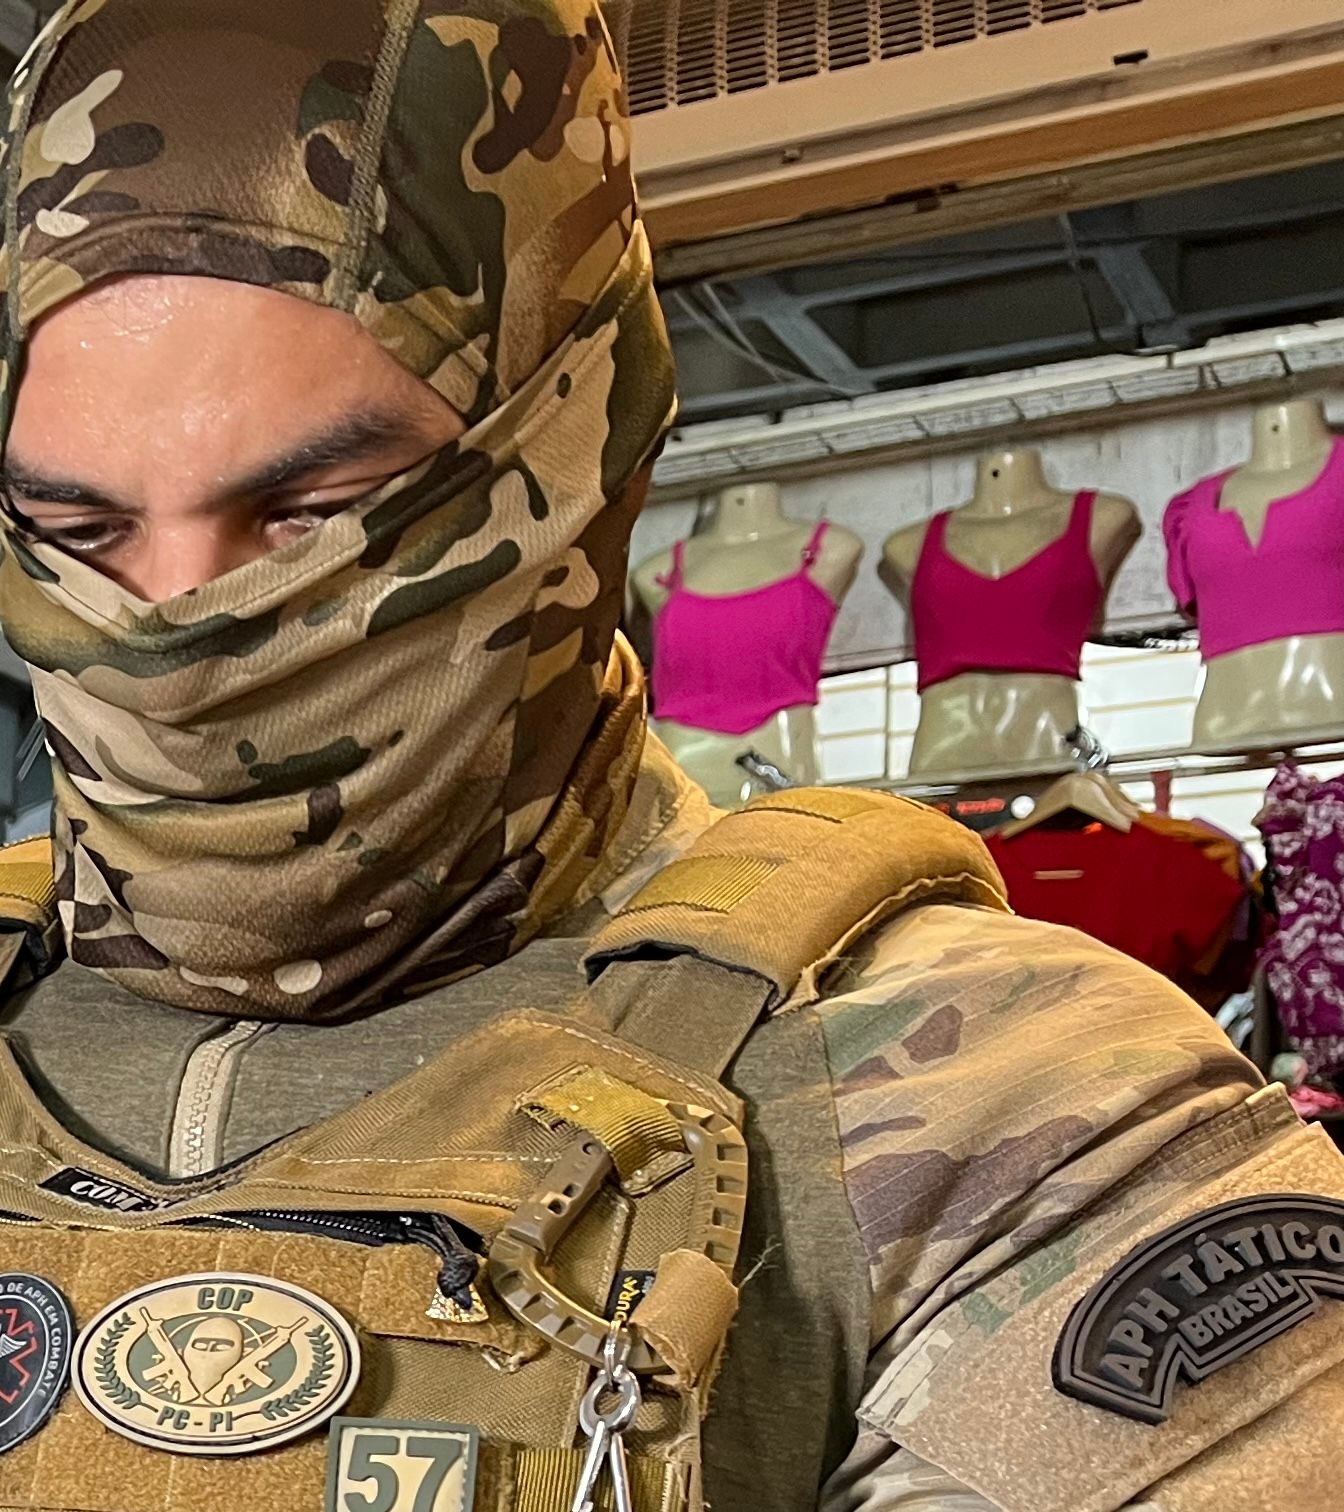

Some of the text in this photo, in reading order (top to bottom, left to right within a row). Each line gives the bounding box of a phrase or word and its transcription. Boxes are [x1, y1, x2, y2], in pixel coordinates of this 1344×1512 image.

[6, 1282, 24, 1294] DE
[23, 1286, 49, 1307] APH
[44, 1306, 59, 1325] EM
[196, 1286, 254, 1312] COP
[1099, 1221, 1344, 1391] APH TÁTICO
[1178, 1271, 1300, 1348] BRASIL
